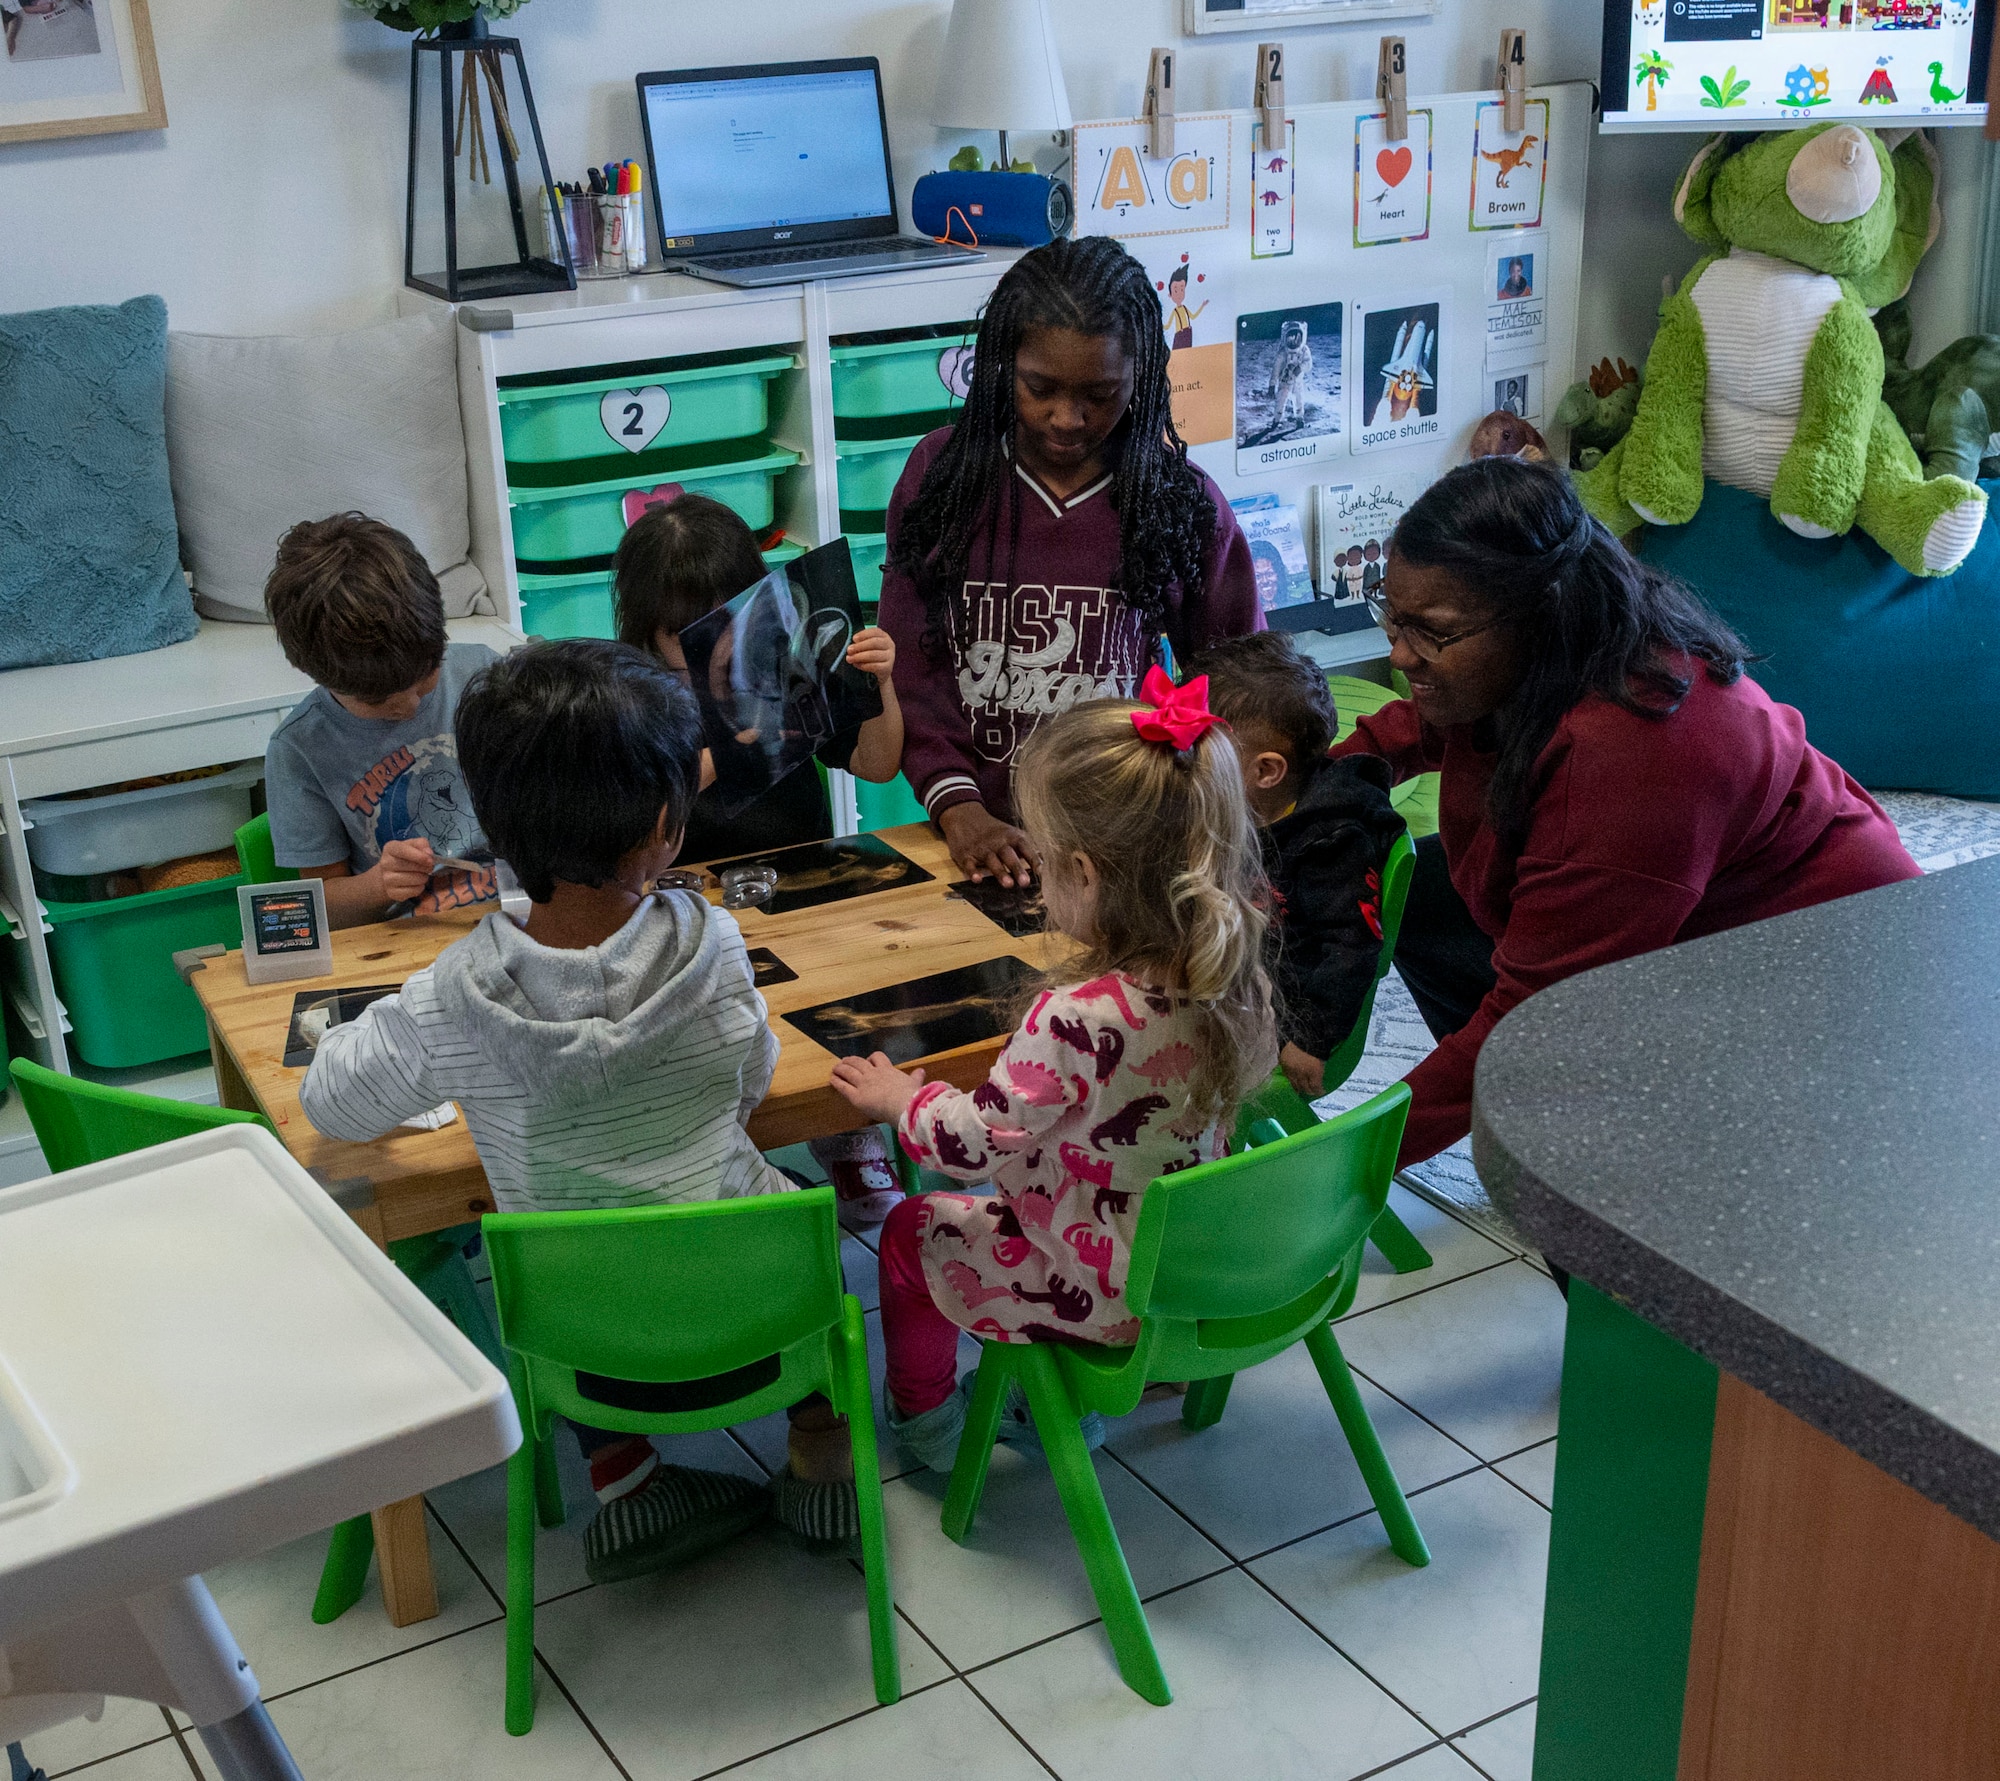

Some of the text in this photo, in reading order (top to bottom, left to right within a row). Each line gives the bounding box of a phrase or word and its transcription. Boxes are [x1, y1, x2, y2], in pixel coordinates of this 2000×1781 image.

[1393, 43, 1405, 74] 3
[1511, 36, 1525, 66] 4
[1163, 55, 1171, 88] 1
[1269, 50, 1281, 82] 2
[1098, 148, 1103, 157] 1
[1143, 145, 1149, 154] 2
[1193, 149, 1198, 157] 1
[1209, 157, 1215, 165] 2
[1101, 146, 1208, 210] A a
[1119, 208, 1126, 217] 3
[1380, 209, 1405, 220] Heart
[1488, 201, 1526, 214] Brown
[774, 231, 793, 240] acer
[1271, 239, 1276, 247] 2
[1503, 302, 1527, 317] MAE
[1488, 311, 1541, 330] JEMISON
[1186, 380, 1203, 391] act.
[622, 402, 644, 436] 2
[1362, 420, 1438, 447] space shuttle
[1260, 442, 1317, 464] astronaut
[1337, 485, 1405, 518] Little Leaders
[346, 745, 416, 818] THRILL
